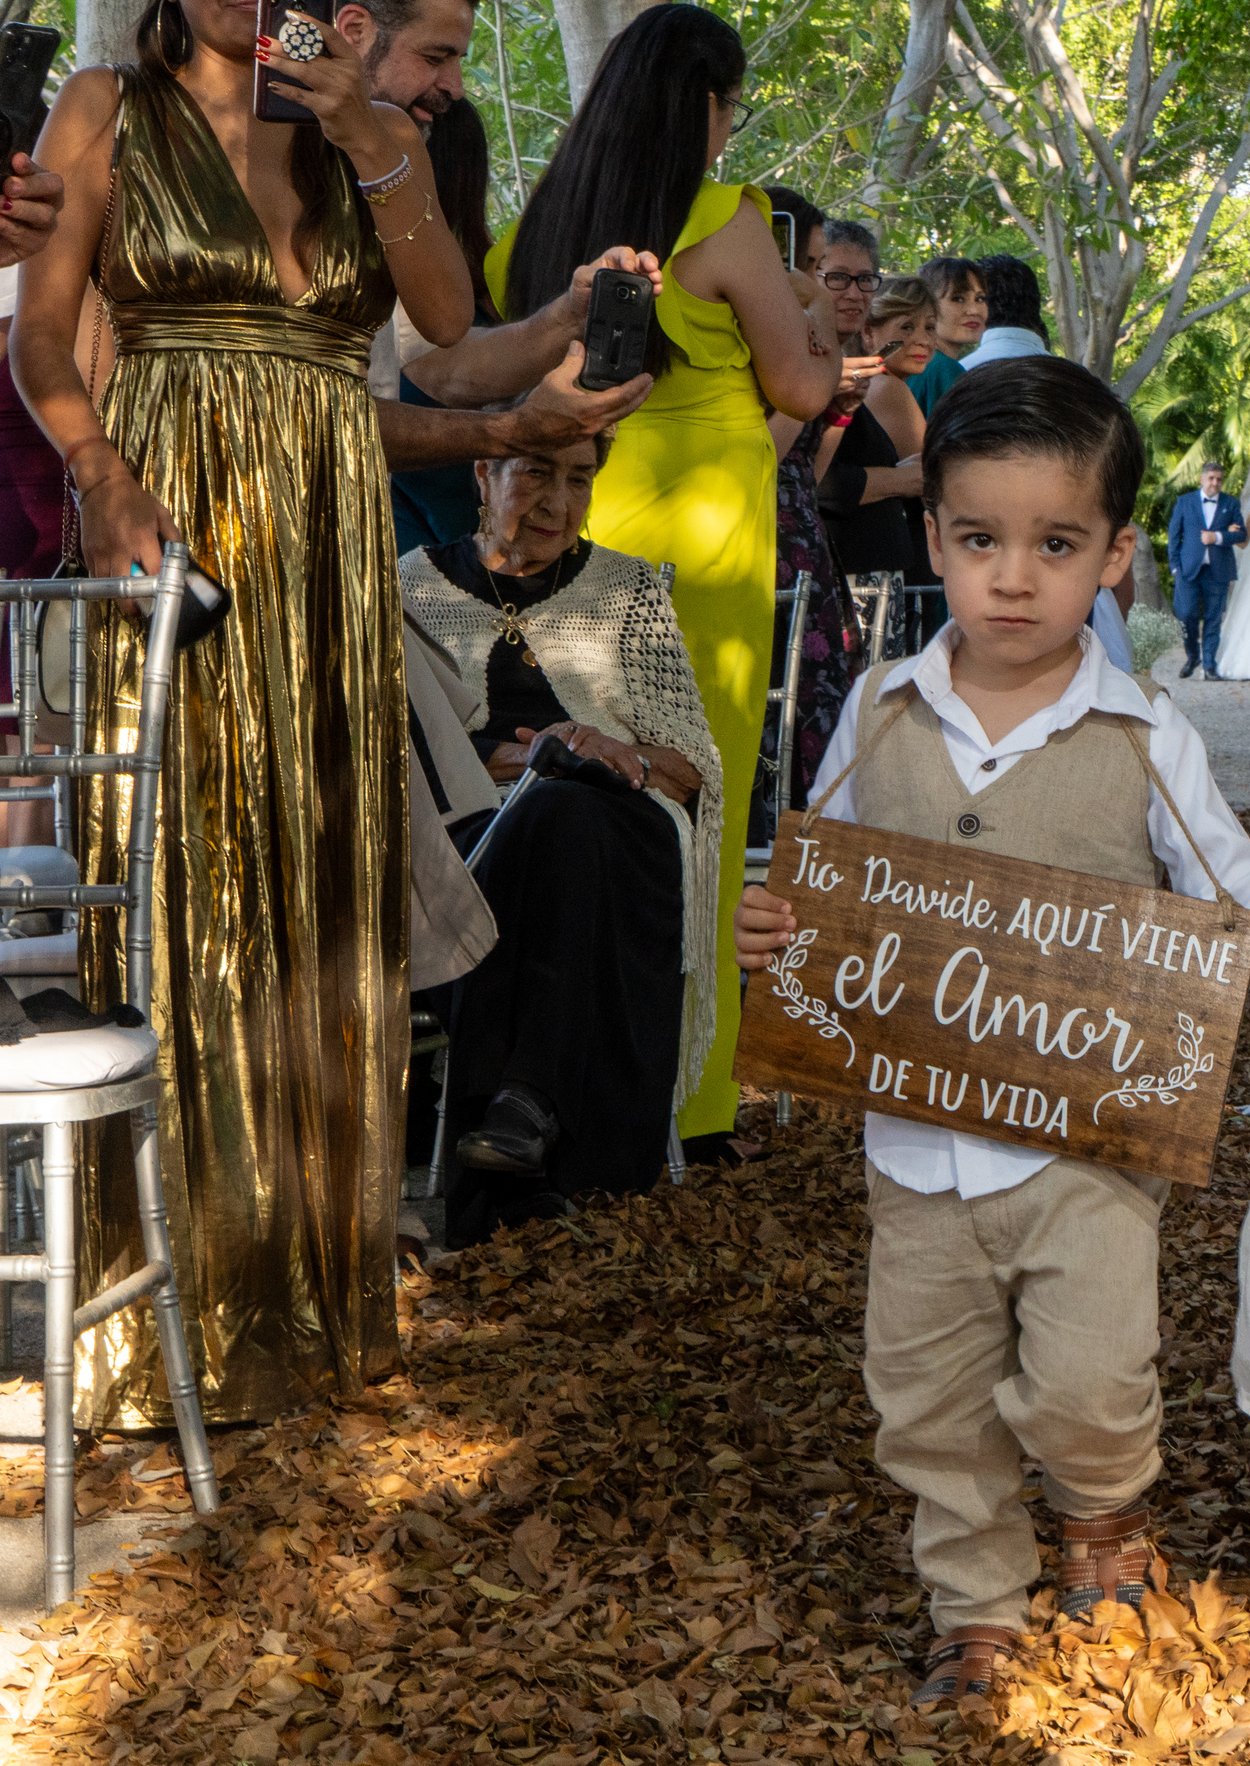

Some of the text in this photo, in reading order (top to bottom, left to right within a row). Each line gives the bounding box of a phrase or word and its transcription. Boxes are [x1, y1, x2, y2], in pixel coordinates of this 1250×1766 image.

[861, 855, 997, 934] Davide,
[1007, 898, 1115, 956] AQUÍ
[1122, 917, 1237, 984] VIENE
[835, 932, 1144, 1073] el Amor
[869, 1053, 1069, 1138] DE TU VIDA
